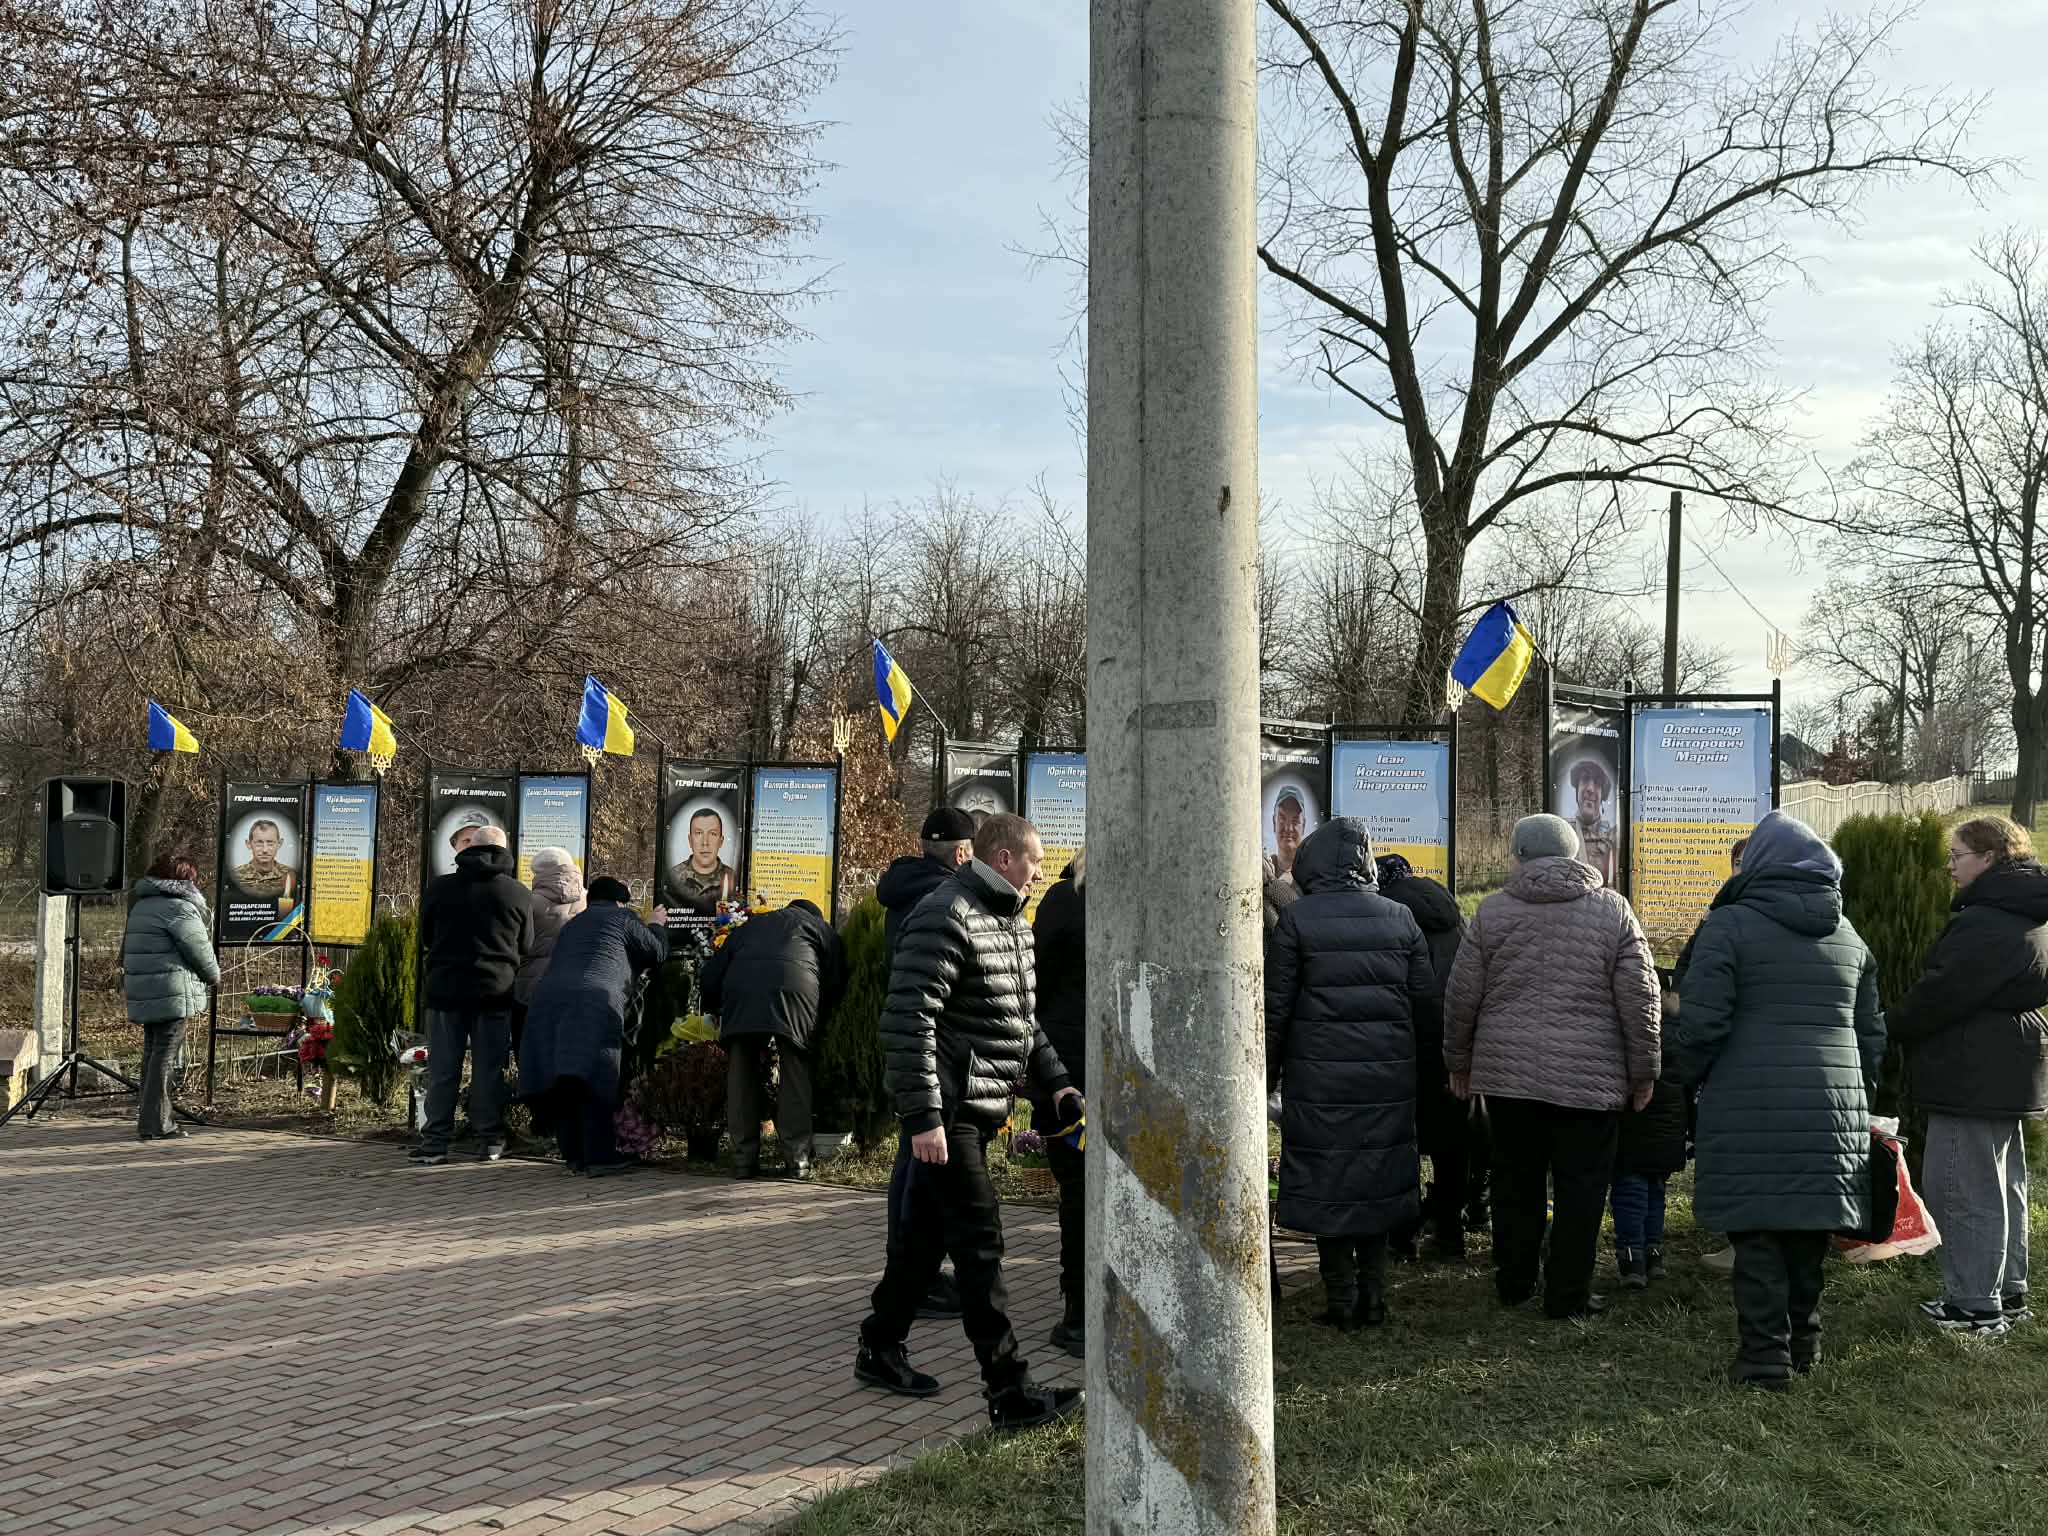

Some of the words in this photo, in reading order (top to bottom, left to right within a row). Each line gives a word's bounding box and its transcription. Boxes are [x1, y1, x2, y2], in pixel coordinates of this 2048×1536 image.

[1663, 723, 1742, 736] Олександр
[1661, 737, 1744, 750] Вікторович
[1288, 754, 1320, 765] ВМИРАЮТЬ
[1376, 754, 1405, 764] Іван
[954, 766, 971, 776] ГЕРОЇ
[971, 768, 979, 776] НЕ
[979, 768, 1012, 777] ВМИРАЮТЬ
[1355, 764, 1425, 777] Йосипович
[675, 779, 694, 788] ГЕРОЇ
[694, 780, 703, 788] НЕ
[703, 781, 738, 790] ВМИРАЮТЬ
[441, 787, 460, 796] ГЕРОЇ
[460, 788, 470, 796] НЕ
[470, 789, 507, 797] ВМИРАЮТЬ
[262, 796, 299, 804] ВМИРАЮТЬ
